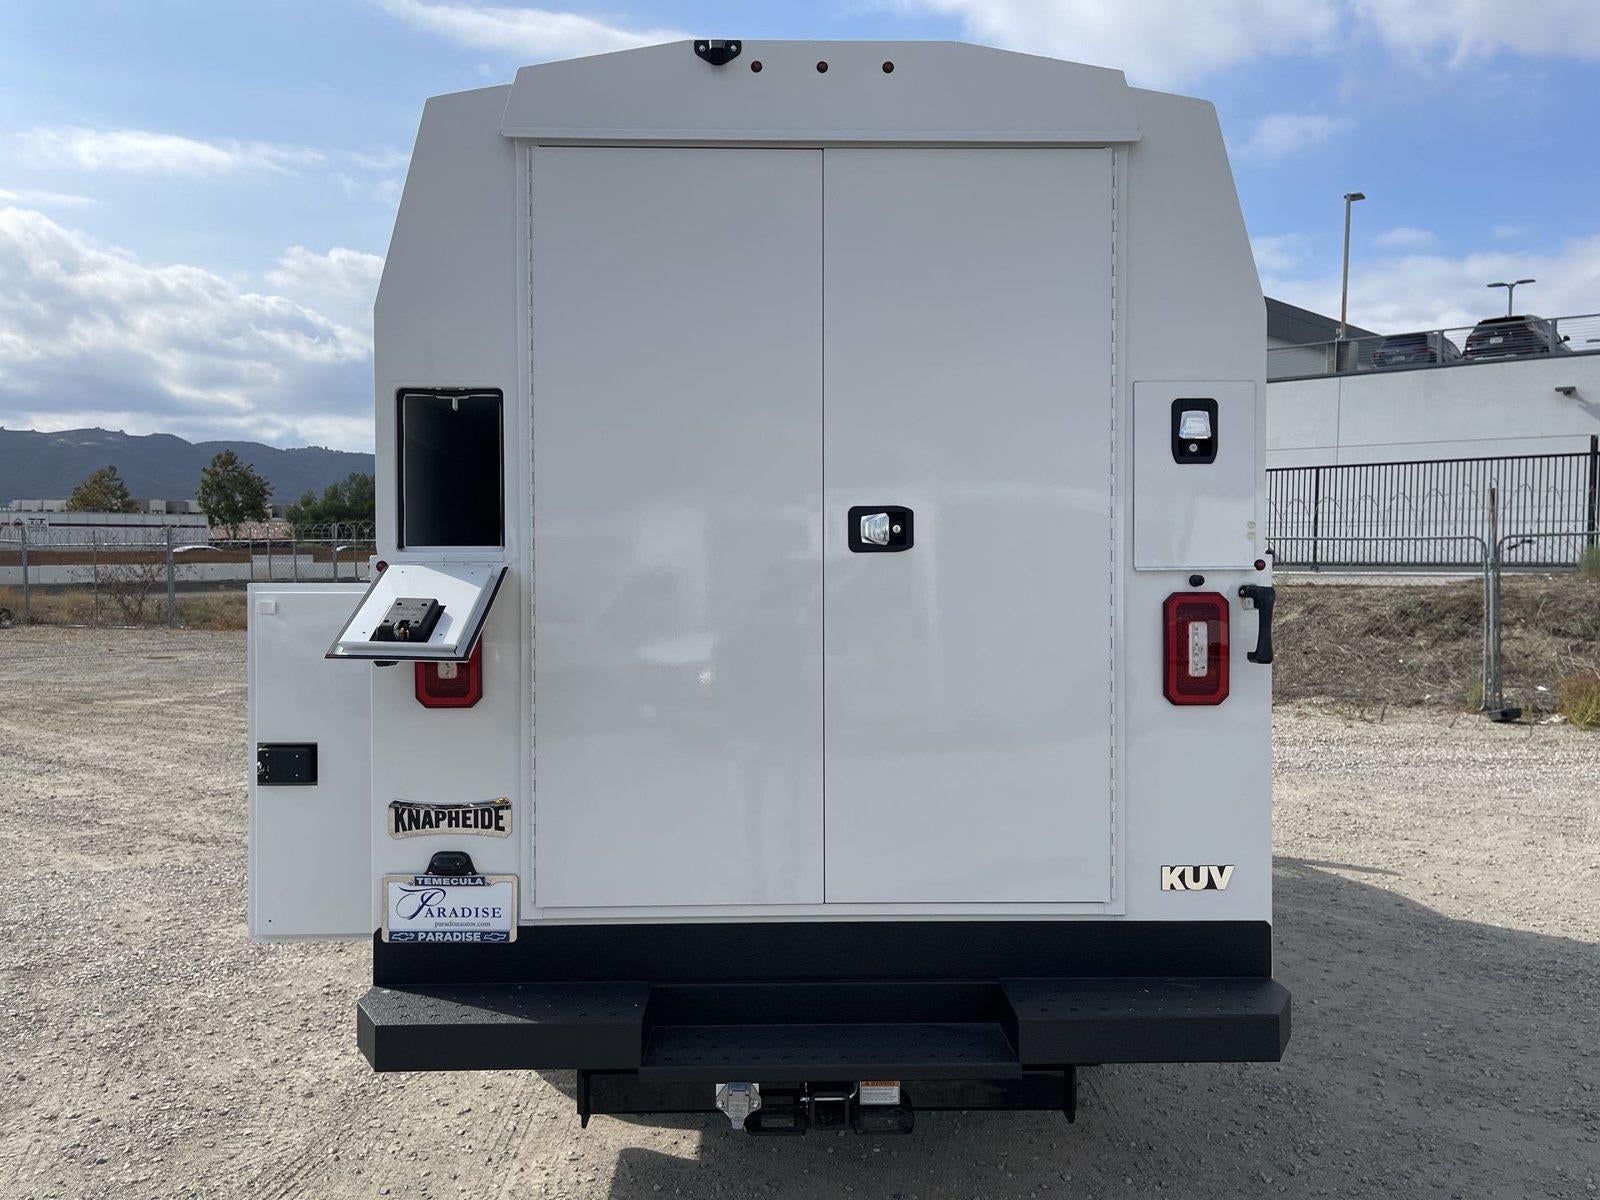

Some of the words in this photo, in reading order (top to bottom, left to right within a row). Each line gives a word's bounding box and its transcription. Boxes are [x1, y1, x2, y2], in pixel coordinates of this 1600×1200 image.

[394, 806, 506, 833] KNAPHEIDE
[416, 877, 484, 886] TEMECULA
[1161, 865, 1235, 891] KUV
[418, 932, 481, 941] PARADISE
